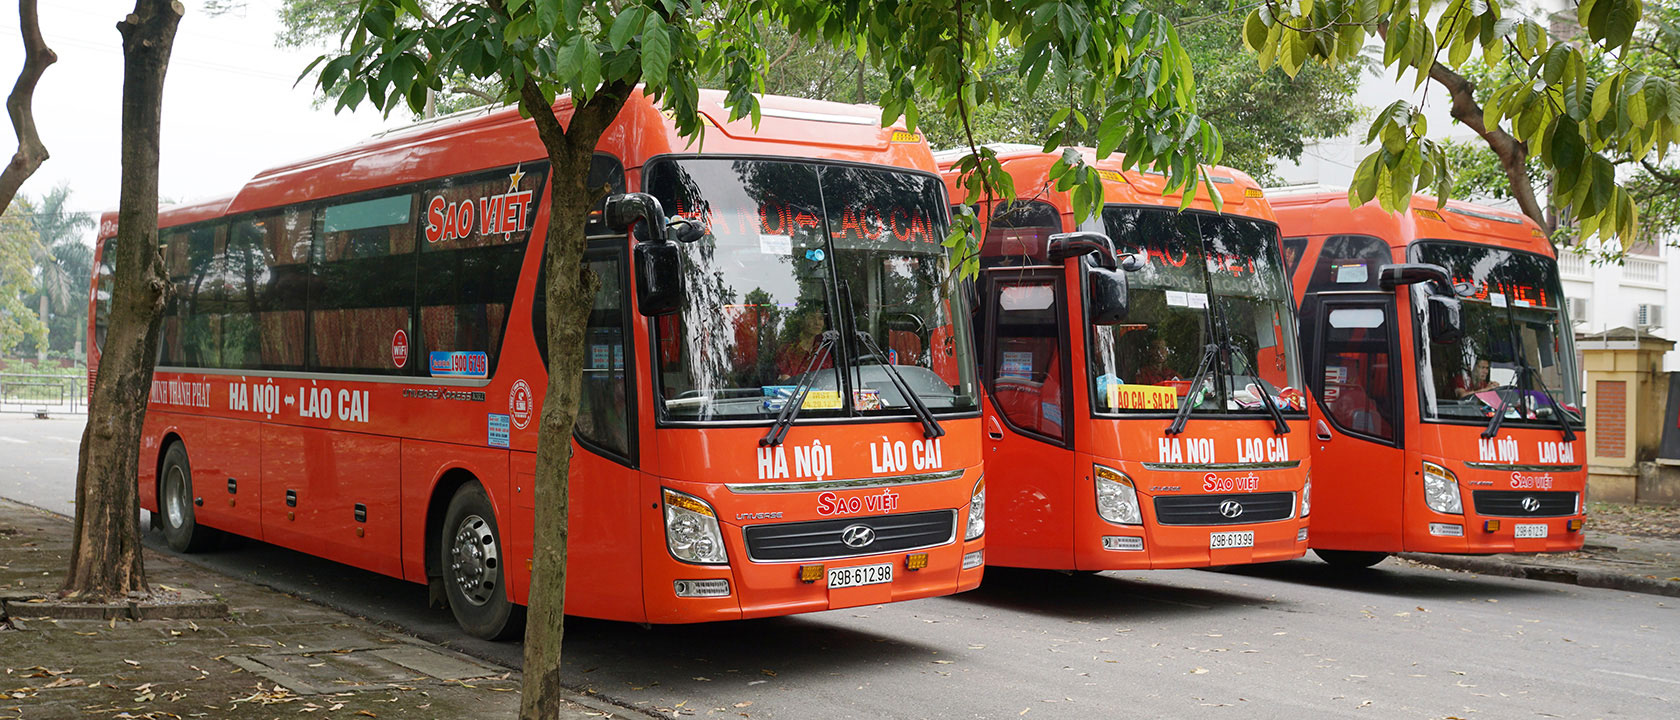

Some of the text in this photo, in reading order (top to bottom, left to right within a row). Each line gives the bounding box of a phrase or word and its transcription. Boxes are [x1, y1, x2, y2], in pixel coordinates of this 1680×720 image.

[425, 189, 533, 243] SAO VIỆT
[451, 354, 467, 372] 1900
[468, 354, 485, 372] 6746
[192, 376, 210, 408] PHÁT
[229, 376, 280, 419] HÀ NỘI
[299, 379, 369, 423] LÀO CAI
[1132, 391, 1146, 409] CAI
[1153, 392, 1164, 409] SA
[1165, 393, 1175, 409] PA
[794, 439, 833, 481] NỘI
[870, 436, 942, 473] LÀO CAI
[1266, 437, 1288, 462] CAI
[1497, 435, 1519, 464] NỘI
[1558, 441, 1574, 463] CAI
[1203, 473, 1259, 492] SAO VIỆT
[1511, 471, 1533, 488] SAO
[817, 489, 899, 516] SAO VIỆT
[830, 566, 891, 587] 29B-612.98
